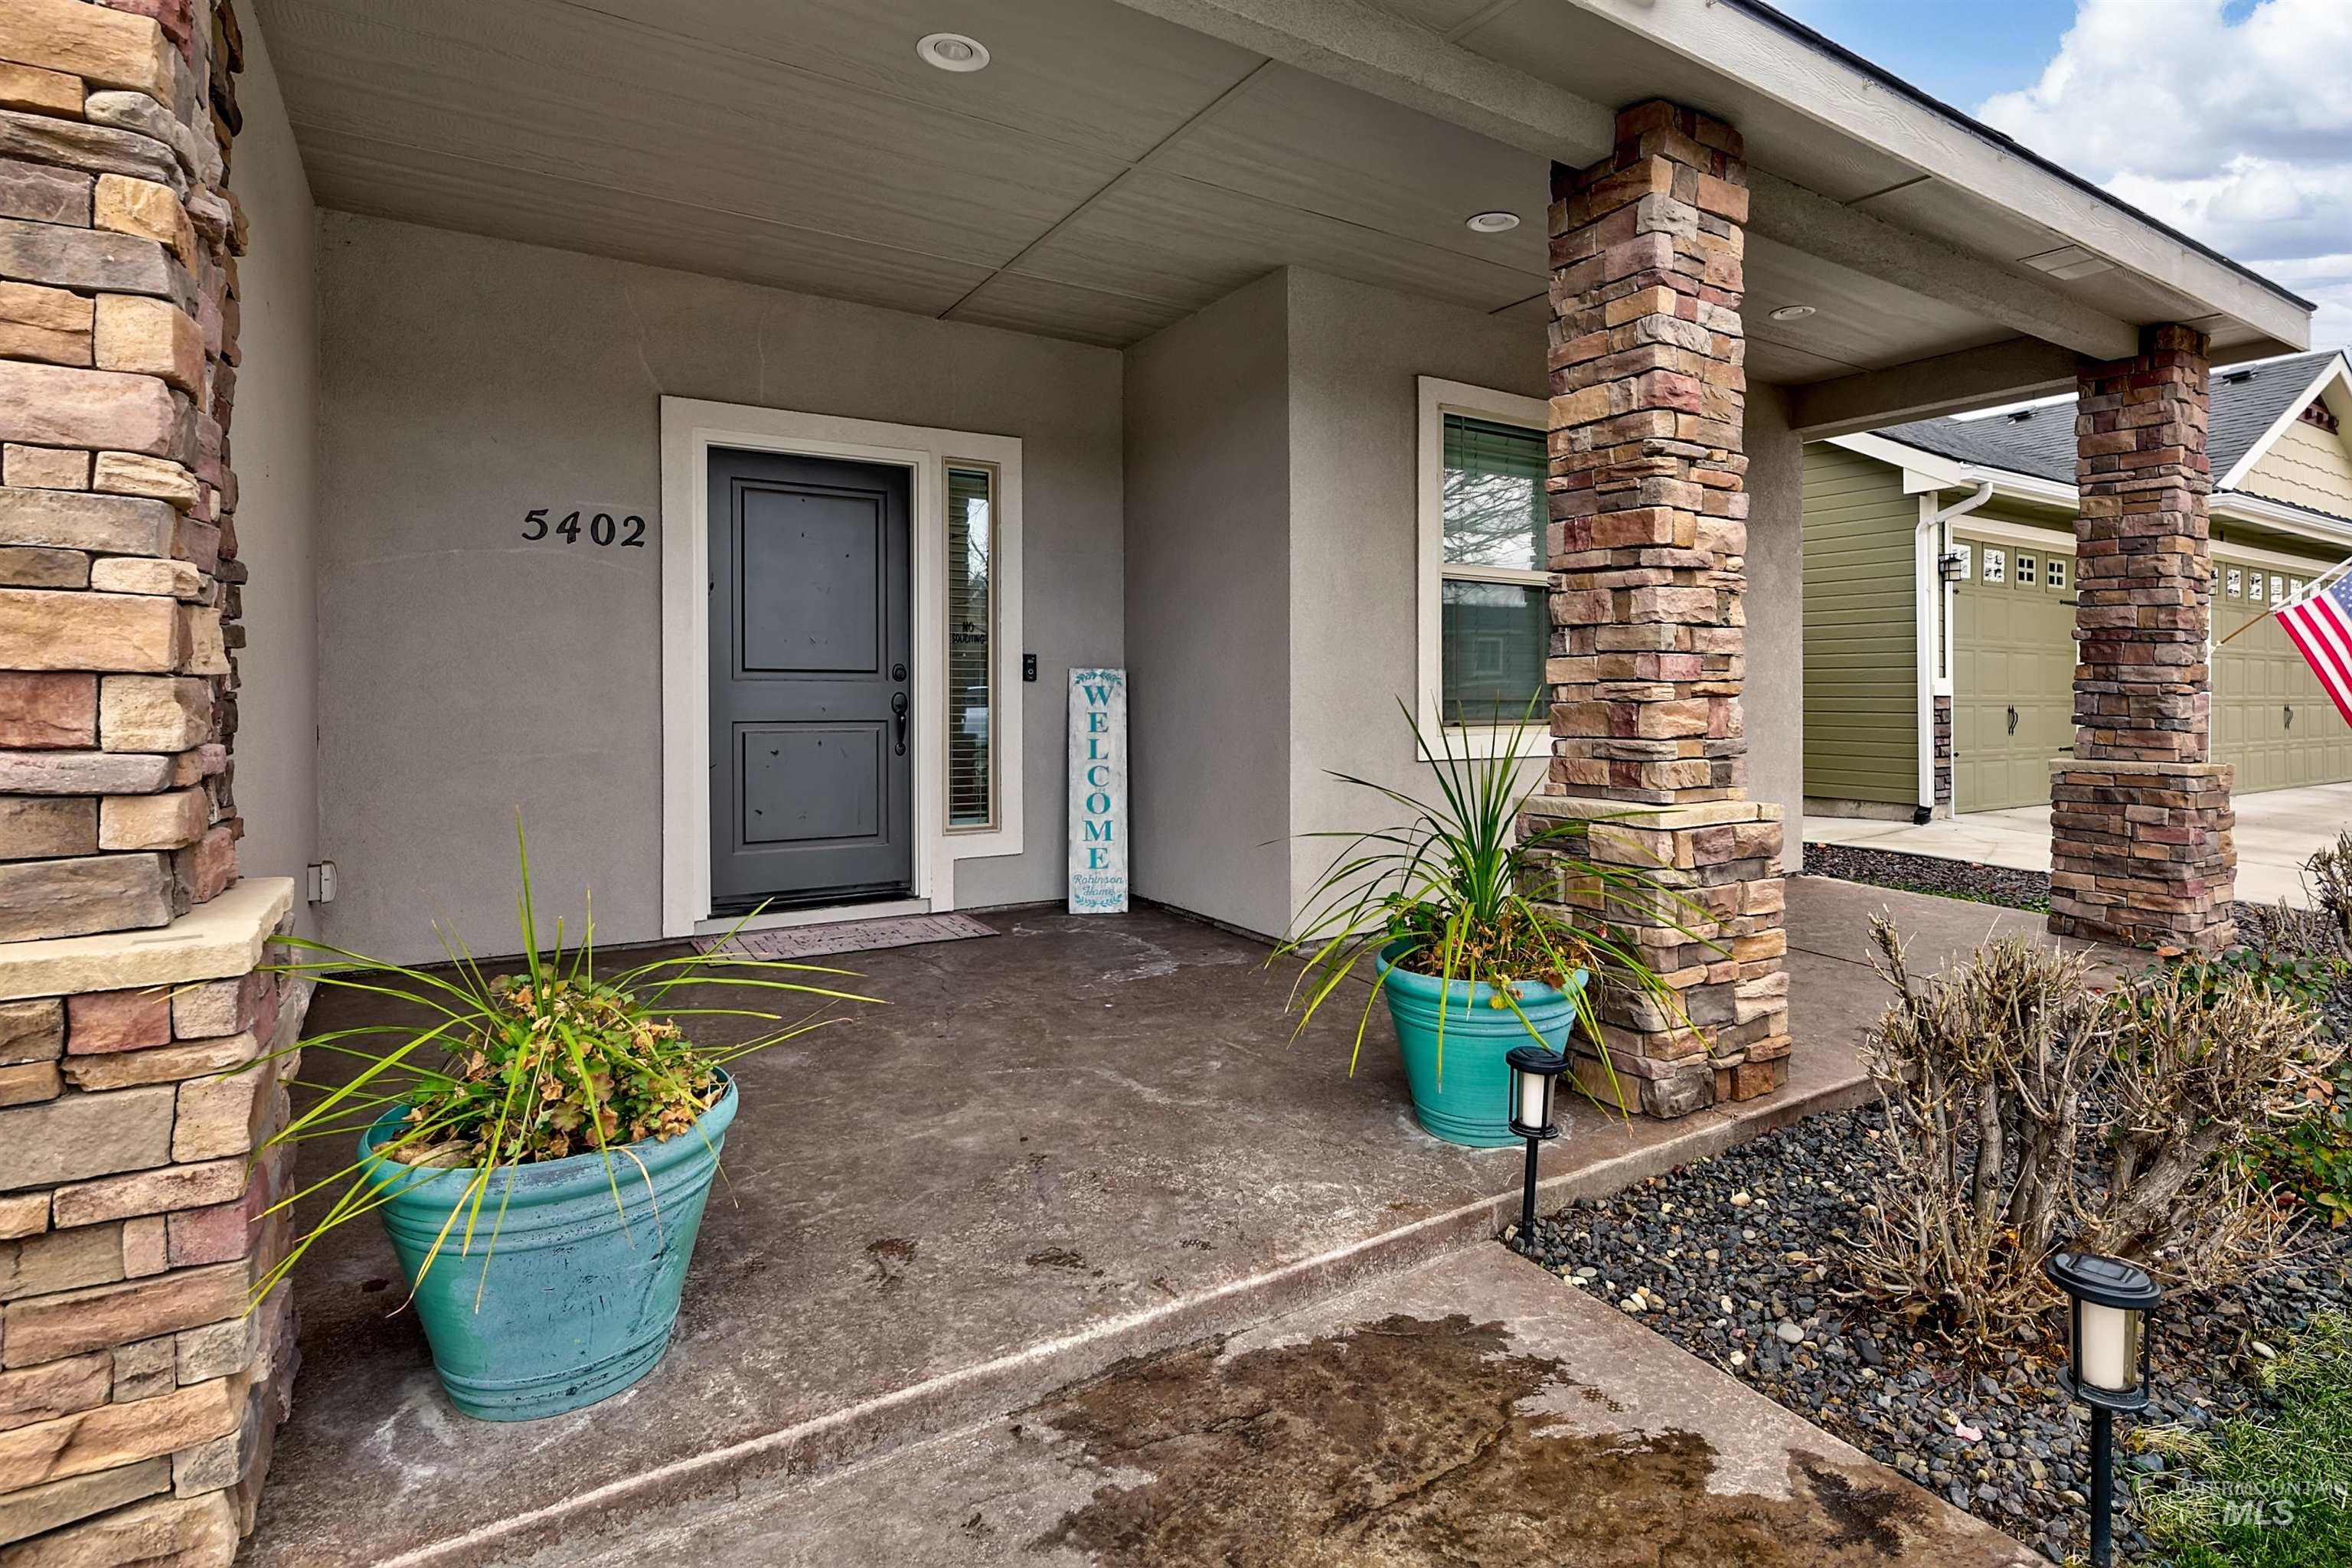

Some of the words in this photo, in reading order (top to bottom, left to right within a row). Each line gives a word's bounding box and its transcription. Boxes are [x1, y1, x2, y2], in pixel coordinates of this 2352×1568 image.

[521, 508, 645, 547] 5402
[962, 621, 974, 632] NO
[952, 633, 985, 644] SOLICITING
[1083, 684, 1115, 870] WELCOME
[1072, 874, 1124, 885] Robinson
